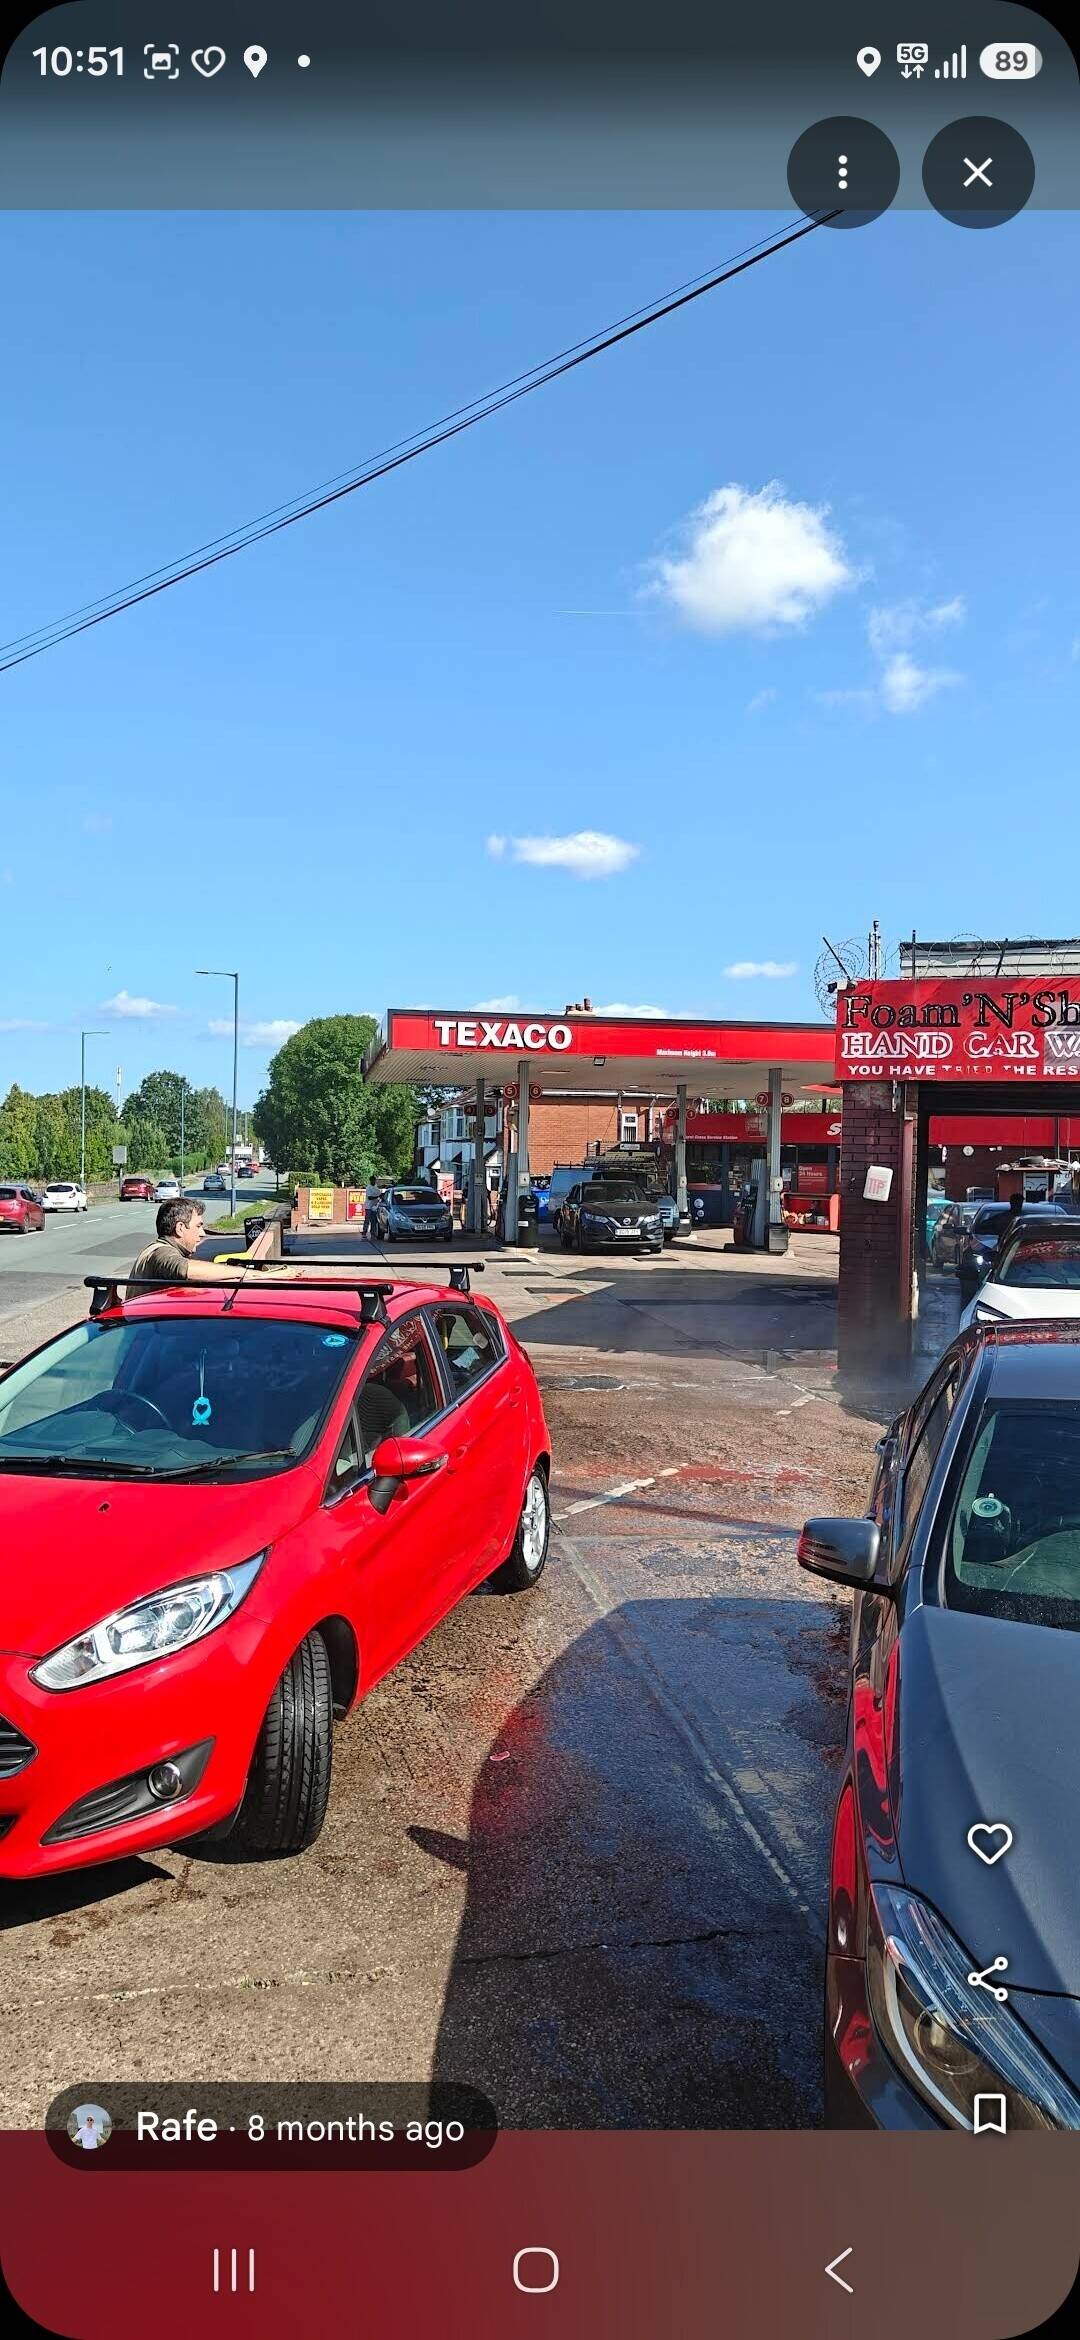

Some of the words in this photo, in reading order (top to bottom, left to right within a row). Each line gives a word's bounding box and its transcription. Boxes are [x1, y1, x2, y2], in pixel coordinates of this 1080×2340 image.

[434, 1020, 573, 1050] TEXACO
[841, 1031, 953, 1059] HAND
[963, 1031, 1040, 1058] CAR
[1044, 1031, 1080, 1058] W
[848, 1065, 883, 1075] YOU
[889, 1065, 936, 1075] HAVE
[1003, 1065, 1038, 1075] THE
[1043, 1065, 1080, 1075] RES
